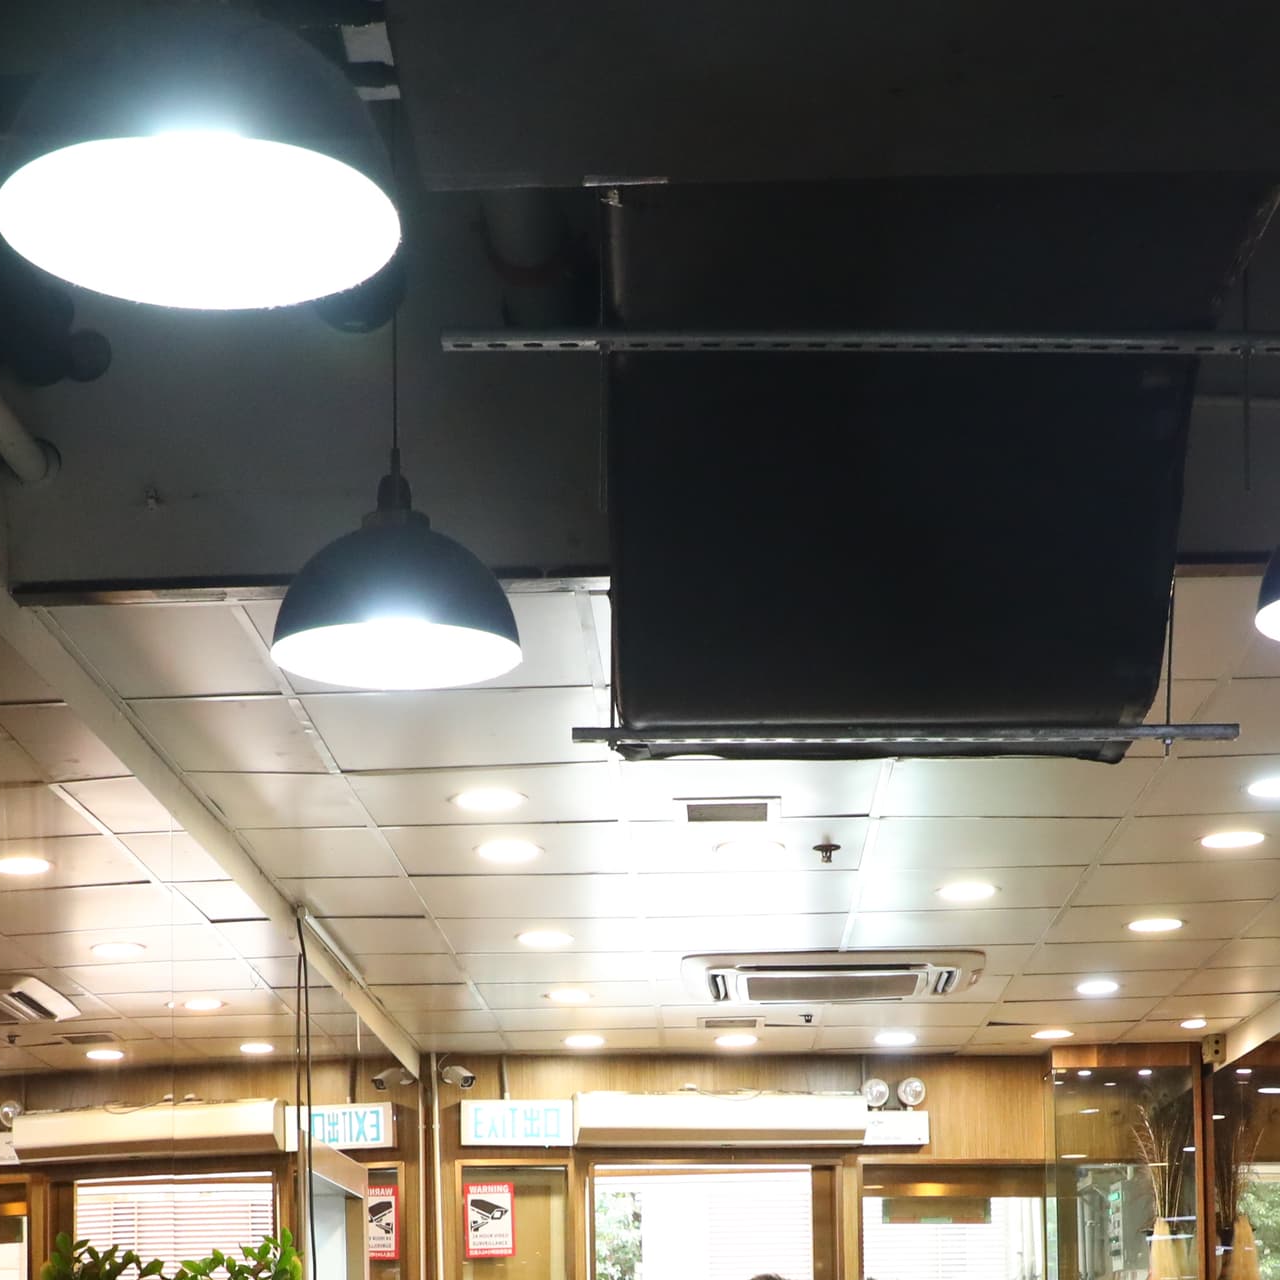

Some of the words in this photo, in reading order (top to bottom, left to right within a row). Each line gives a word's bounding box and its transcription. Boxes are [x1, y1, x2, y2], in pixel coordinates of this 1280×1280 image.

[474, 1107, 518, 1139] EXIT
[523, 1107, 561, 1139] 出口
[469, 1184, 509, 1194] WARNING
